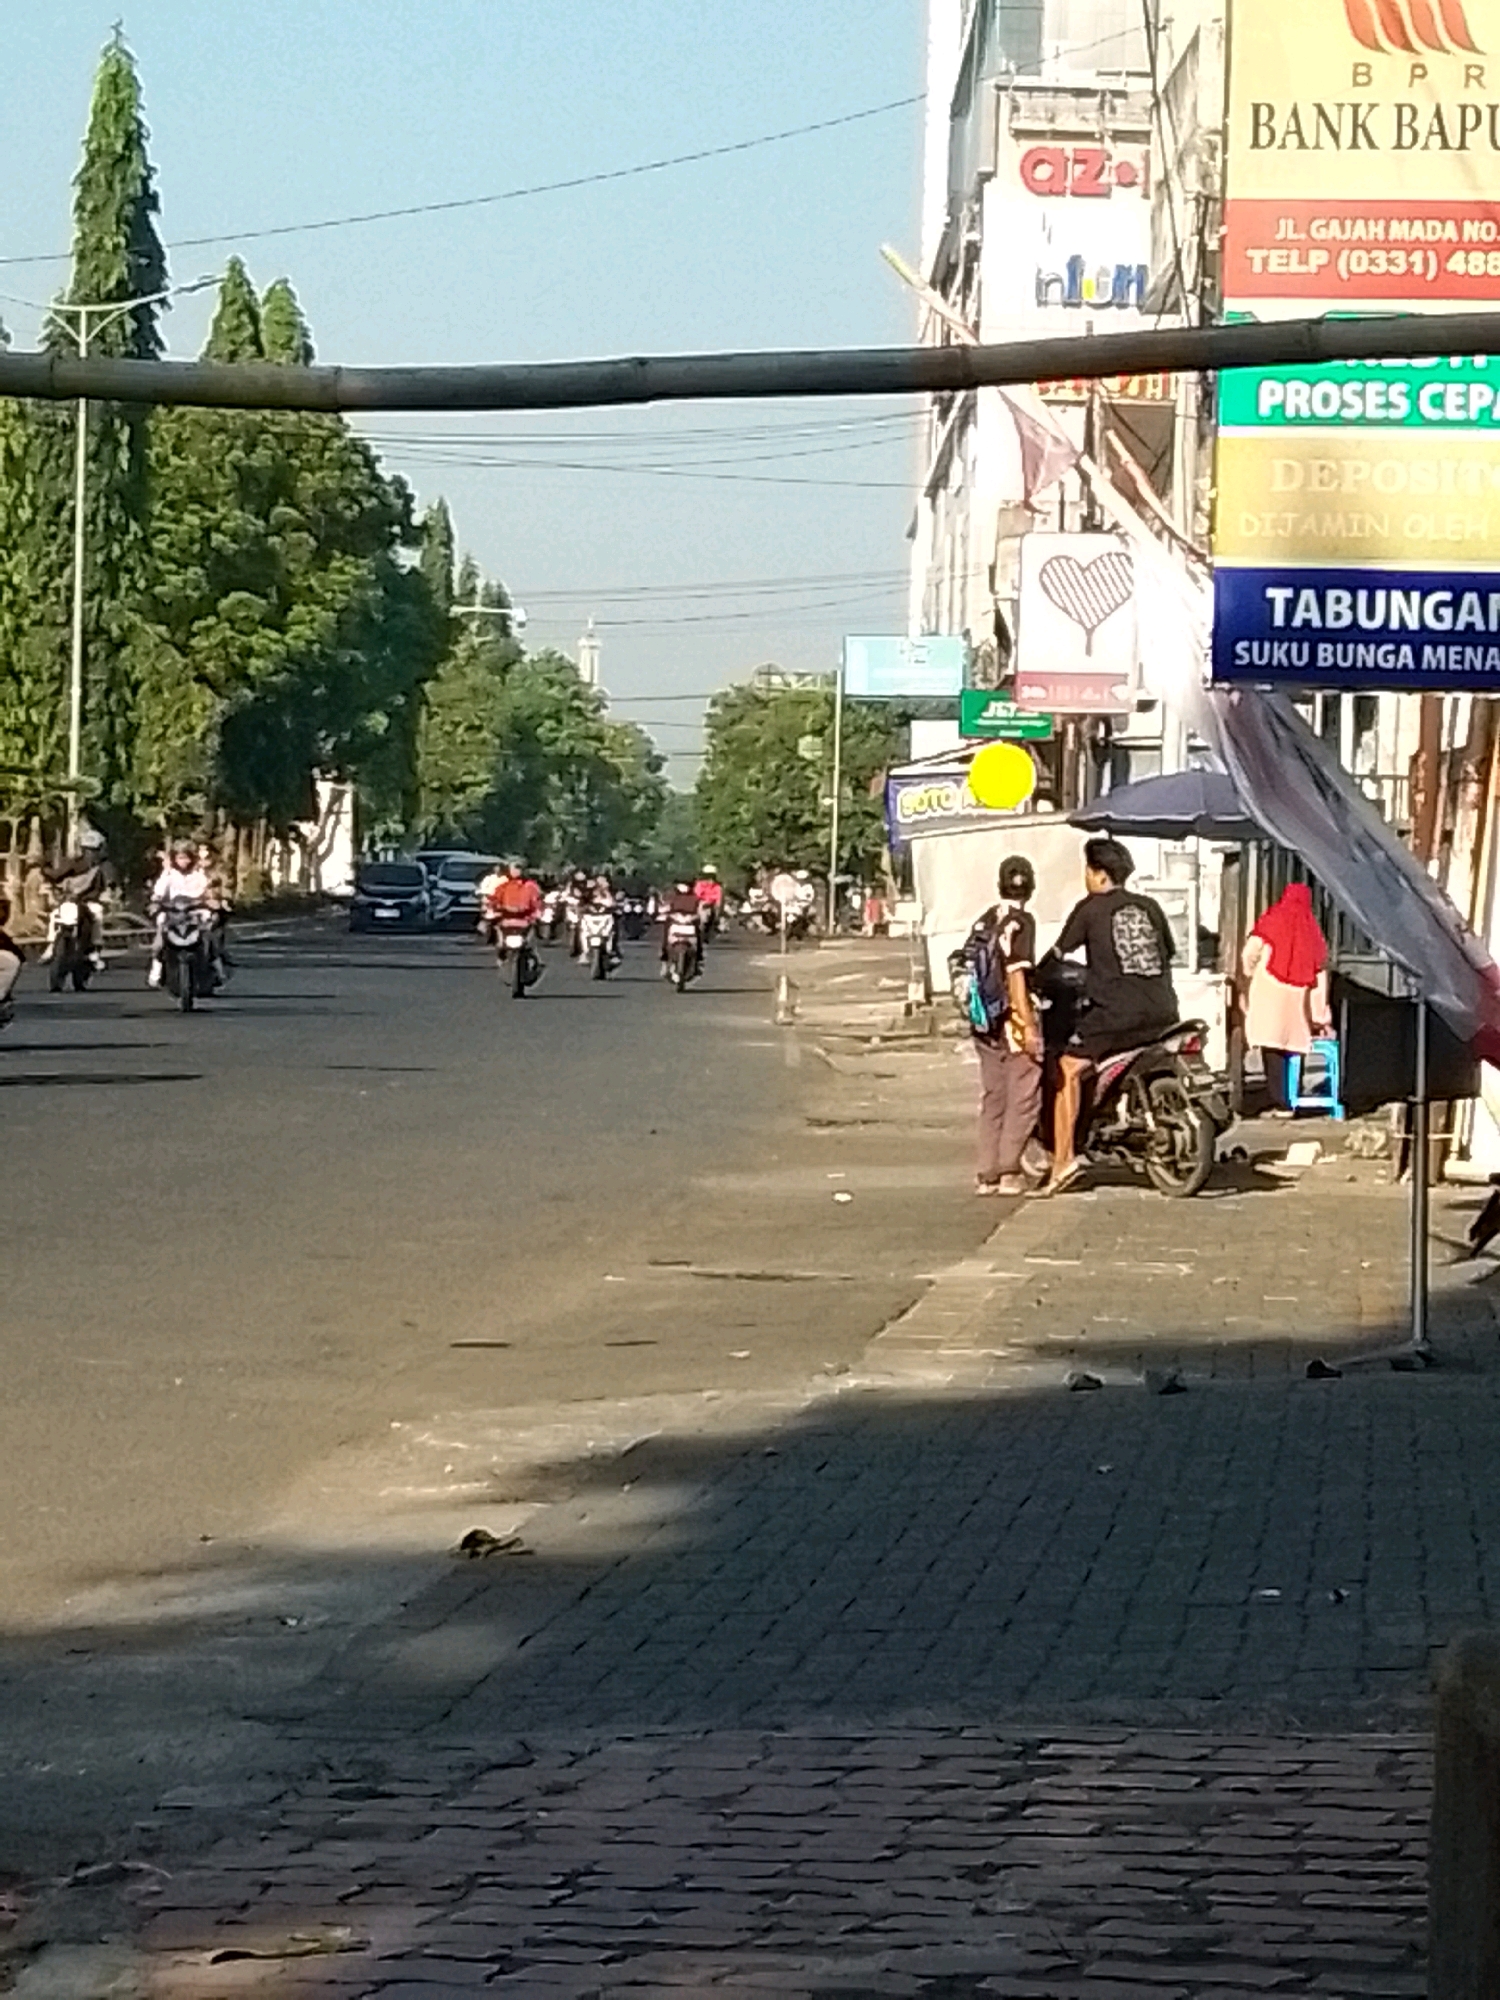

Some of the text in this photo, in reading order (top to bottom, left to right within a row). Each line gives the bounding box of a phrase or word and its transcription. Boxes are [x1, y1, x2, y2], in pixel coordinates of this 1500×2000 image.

[1250, 102, 1381, 150] BANK
[1275, 218, 1305, 241] JL.
[1310, 219, 1386, 241] GAJAH
[1388, 219, 1459, 242] MADA
[1247, 248, 1500, 281] TELP (0331) 488
[1258, 379, 1411, 419] PROSES
[1239, 511, 1489, 541] DIJAMIN OLEH
[1234, 640, 1500, 671] SUKU BUNGA MENA
[900, 785, 956, 818] SOTO
